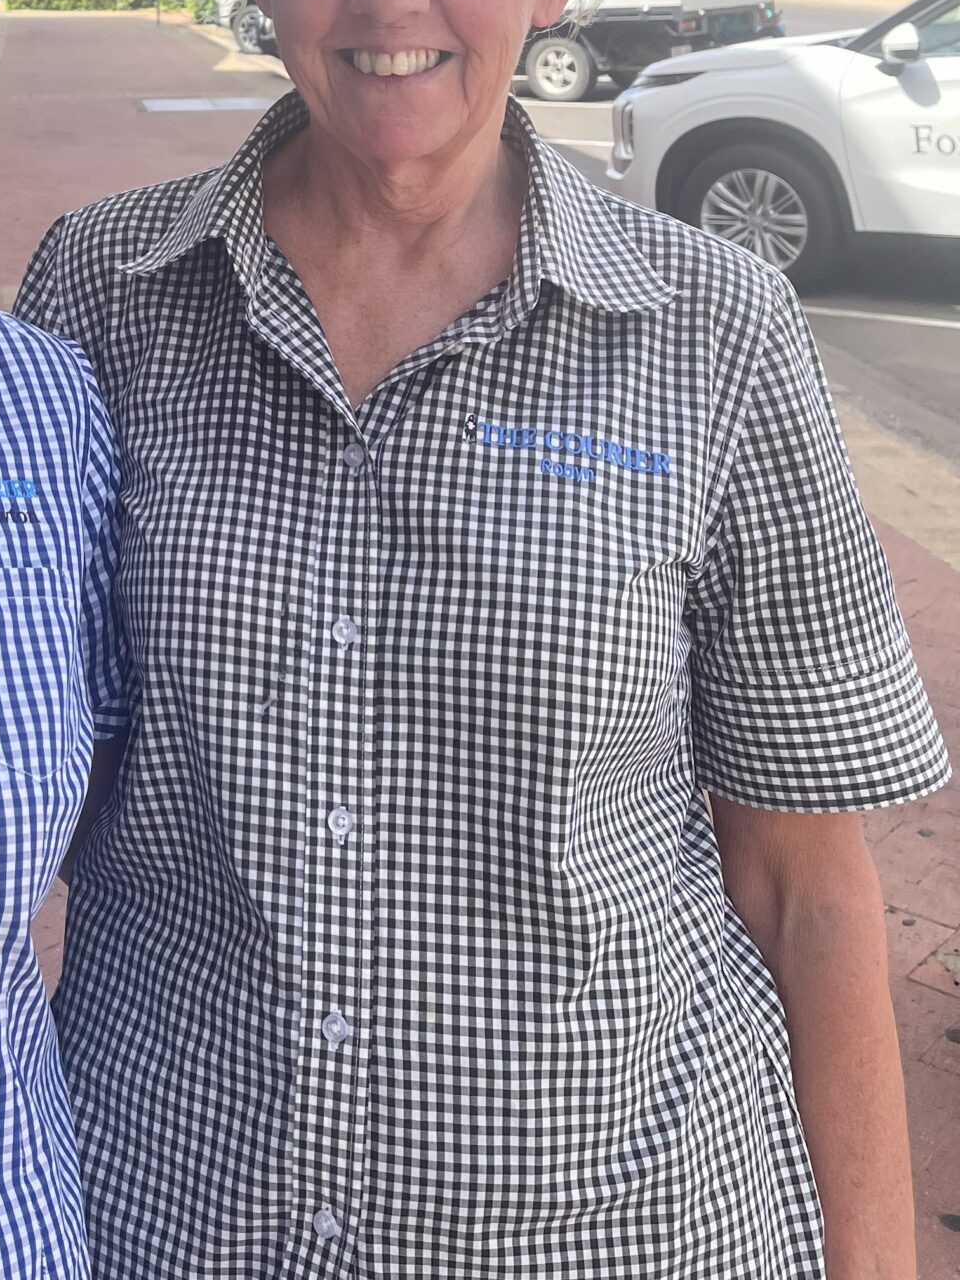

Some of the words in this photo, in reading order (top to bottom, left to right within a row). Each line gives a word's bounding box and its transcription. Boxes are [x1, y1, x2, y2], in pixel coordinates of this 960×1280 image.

[910, 124, 960, 156] Fo
[478, 421, 537, 449] THE
[543, 431, 672, 474] COURIER
